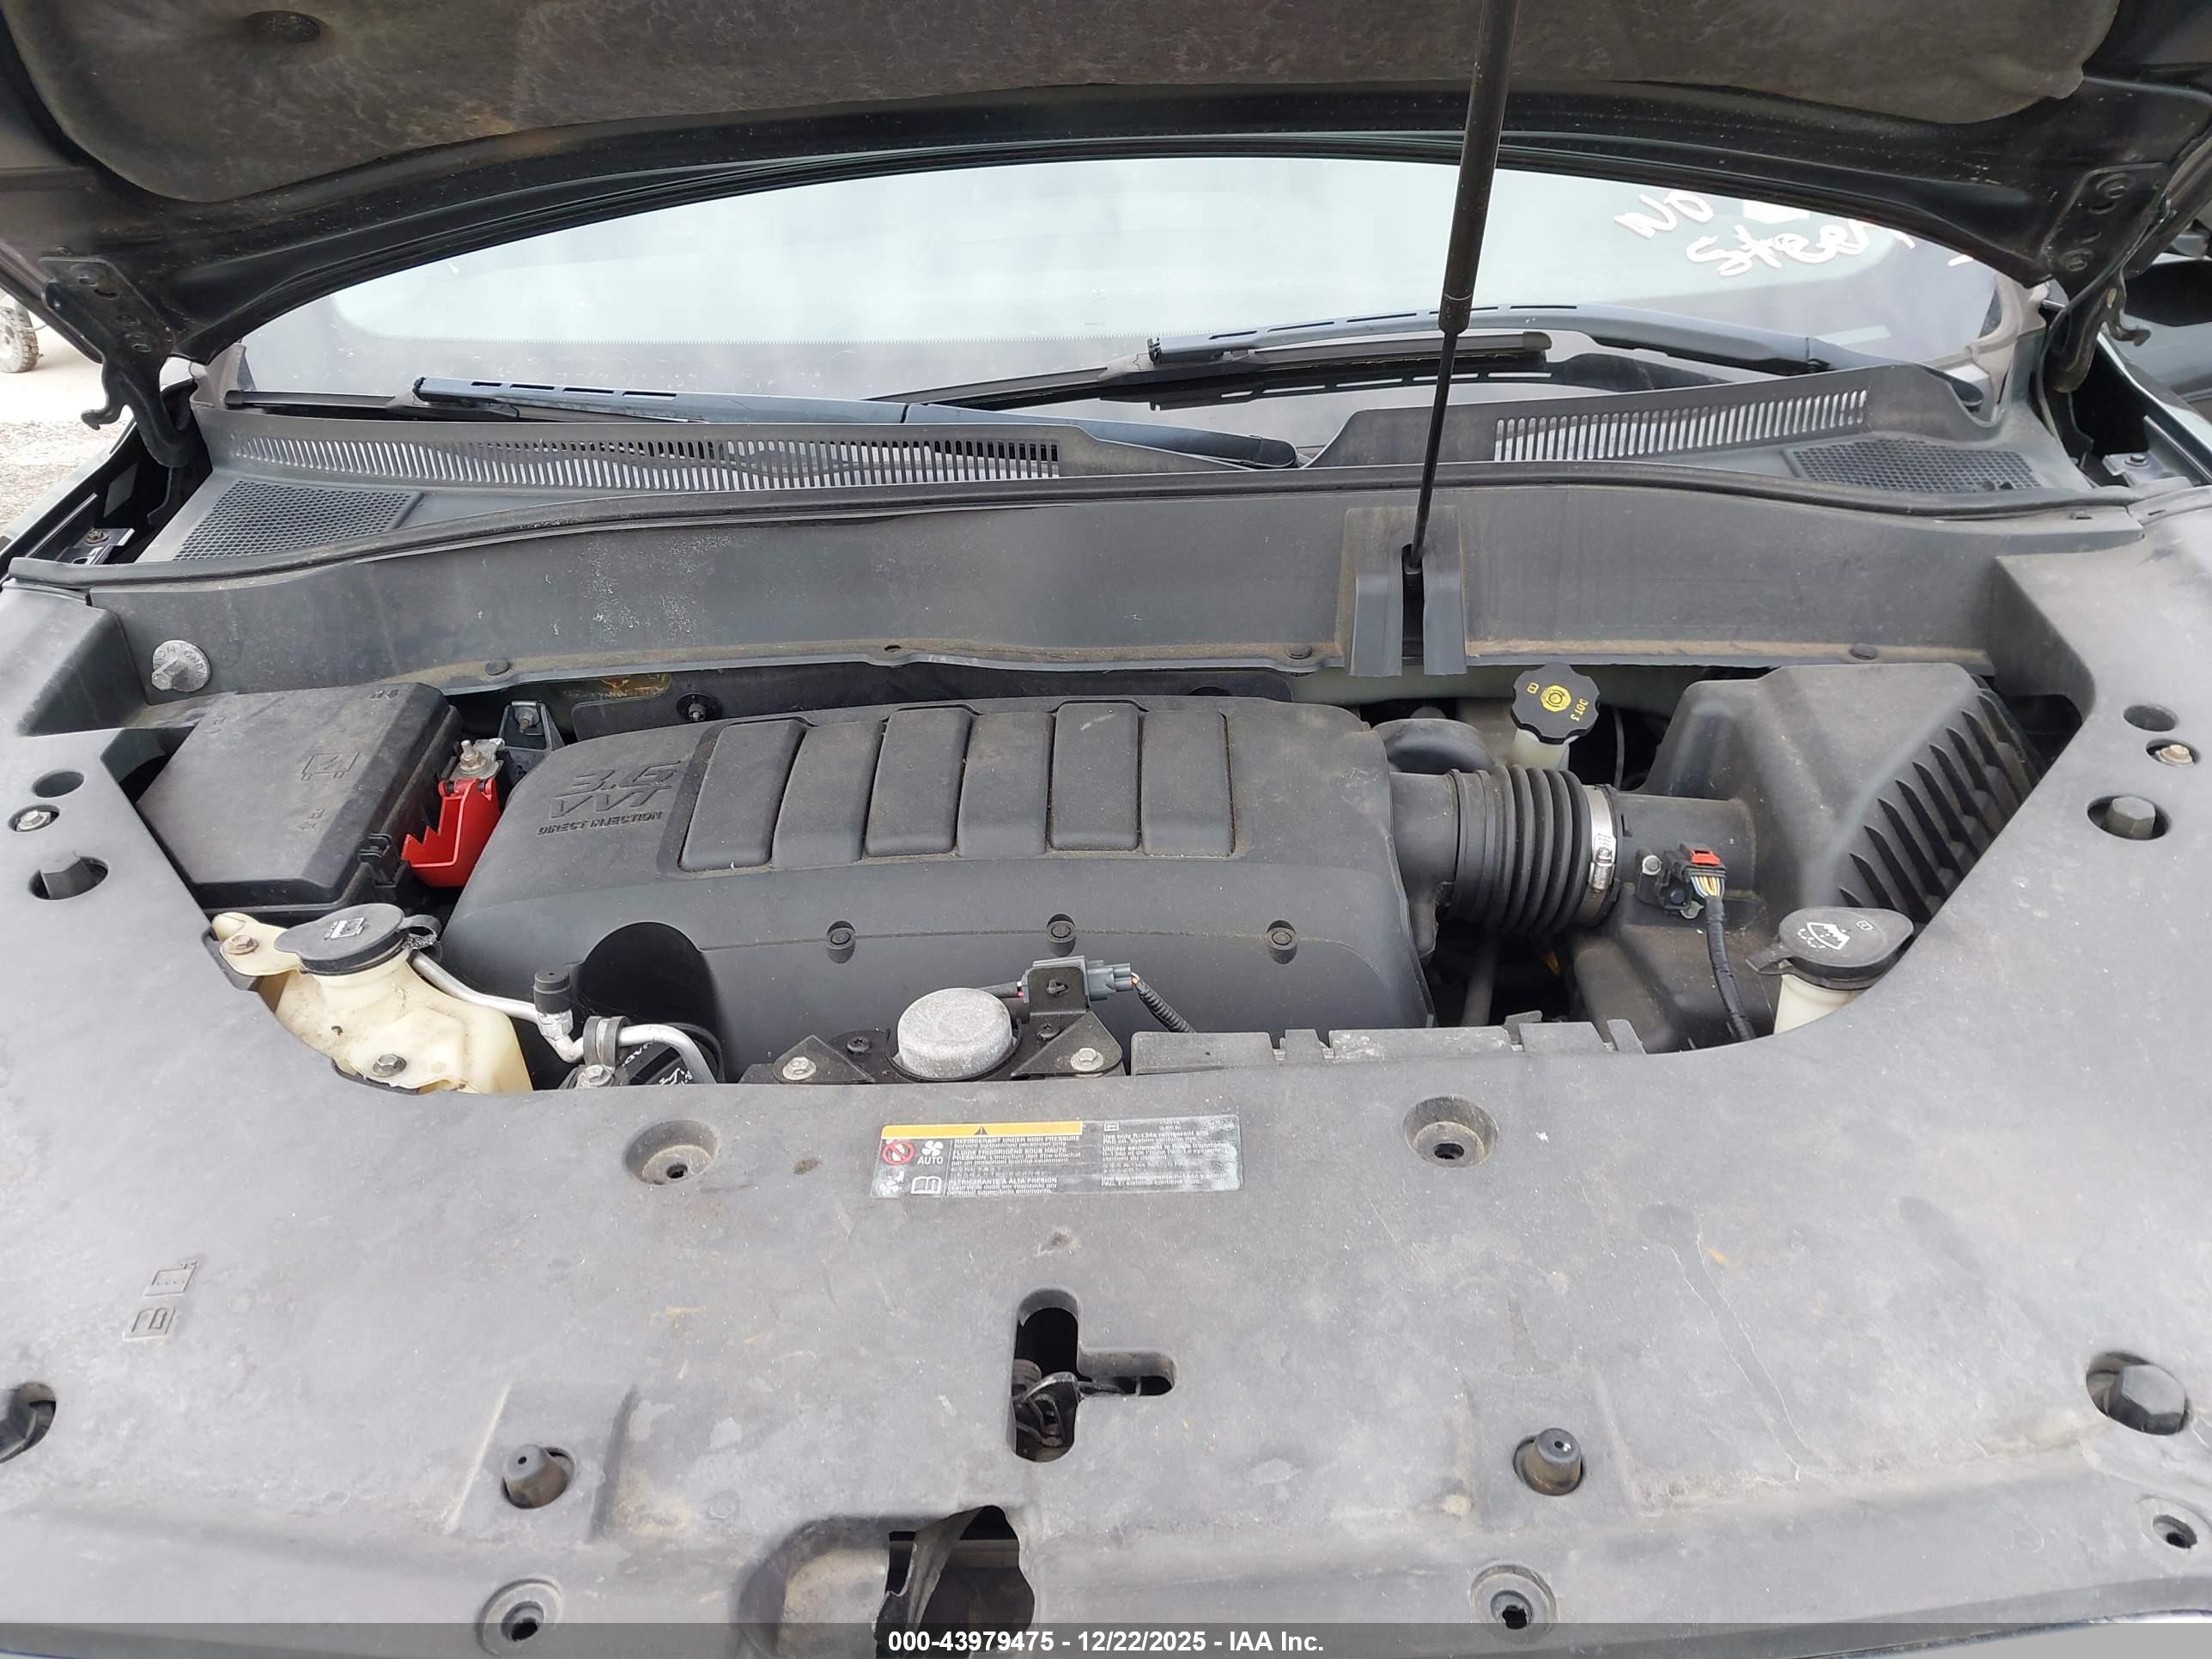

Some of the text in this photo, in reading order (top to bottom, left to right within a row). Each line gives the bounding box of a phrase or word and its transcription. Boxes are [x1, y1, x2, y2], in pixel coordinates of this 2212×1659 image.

[555, 761, 681, 798] 3.6
[550, 784, 673, 819] VVT
[537, 811, 664, 836] DIRECT INJECTION
[917, 1156, 943, 1165] AUTO
